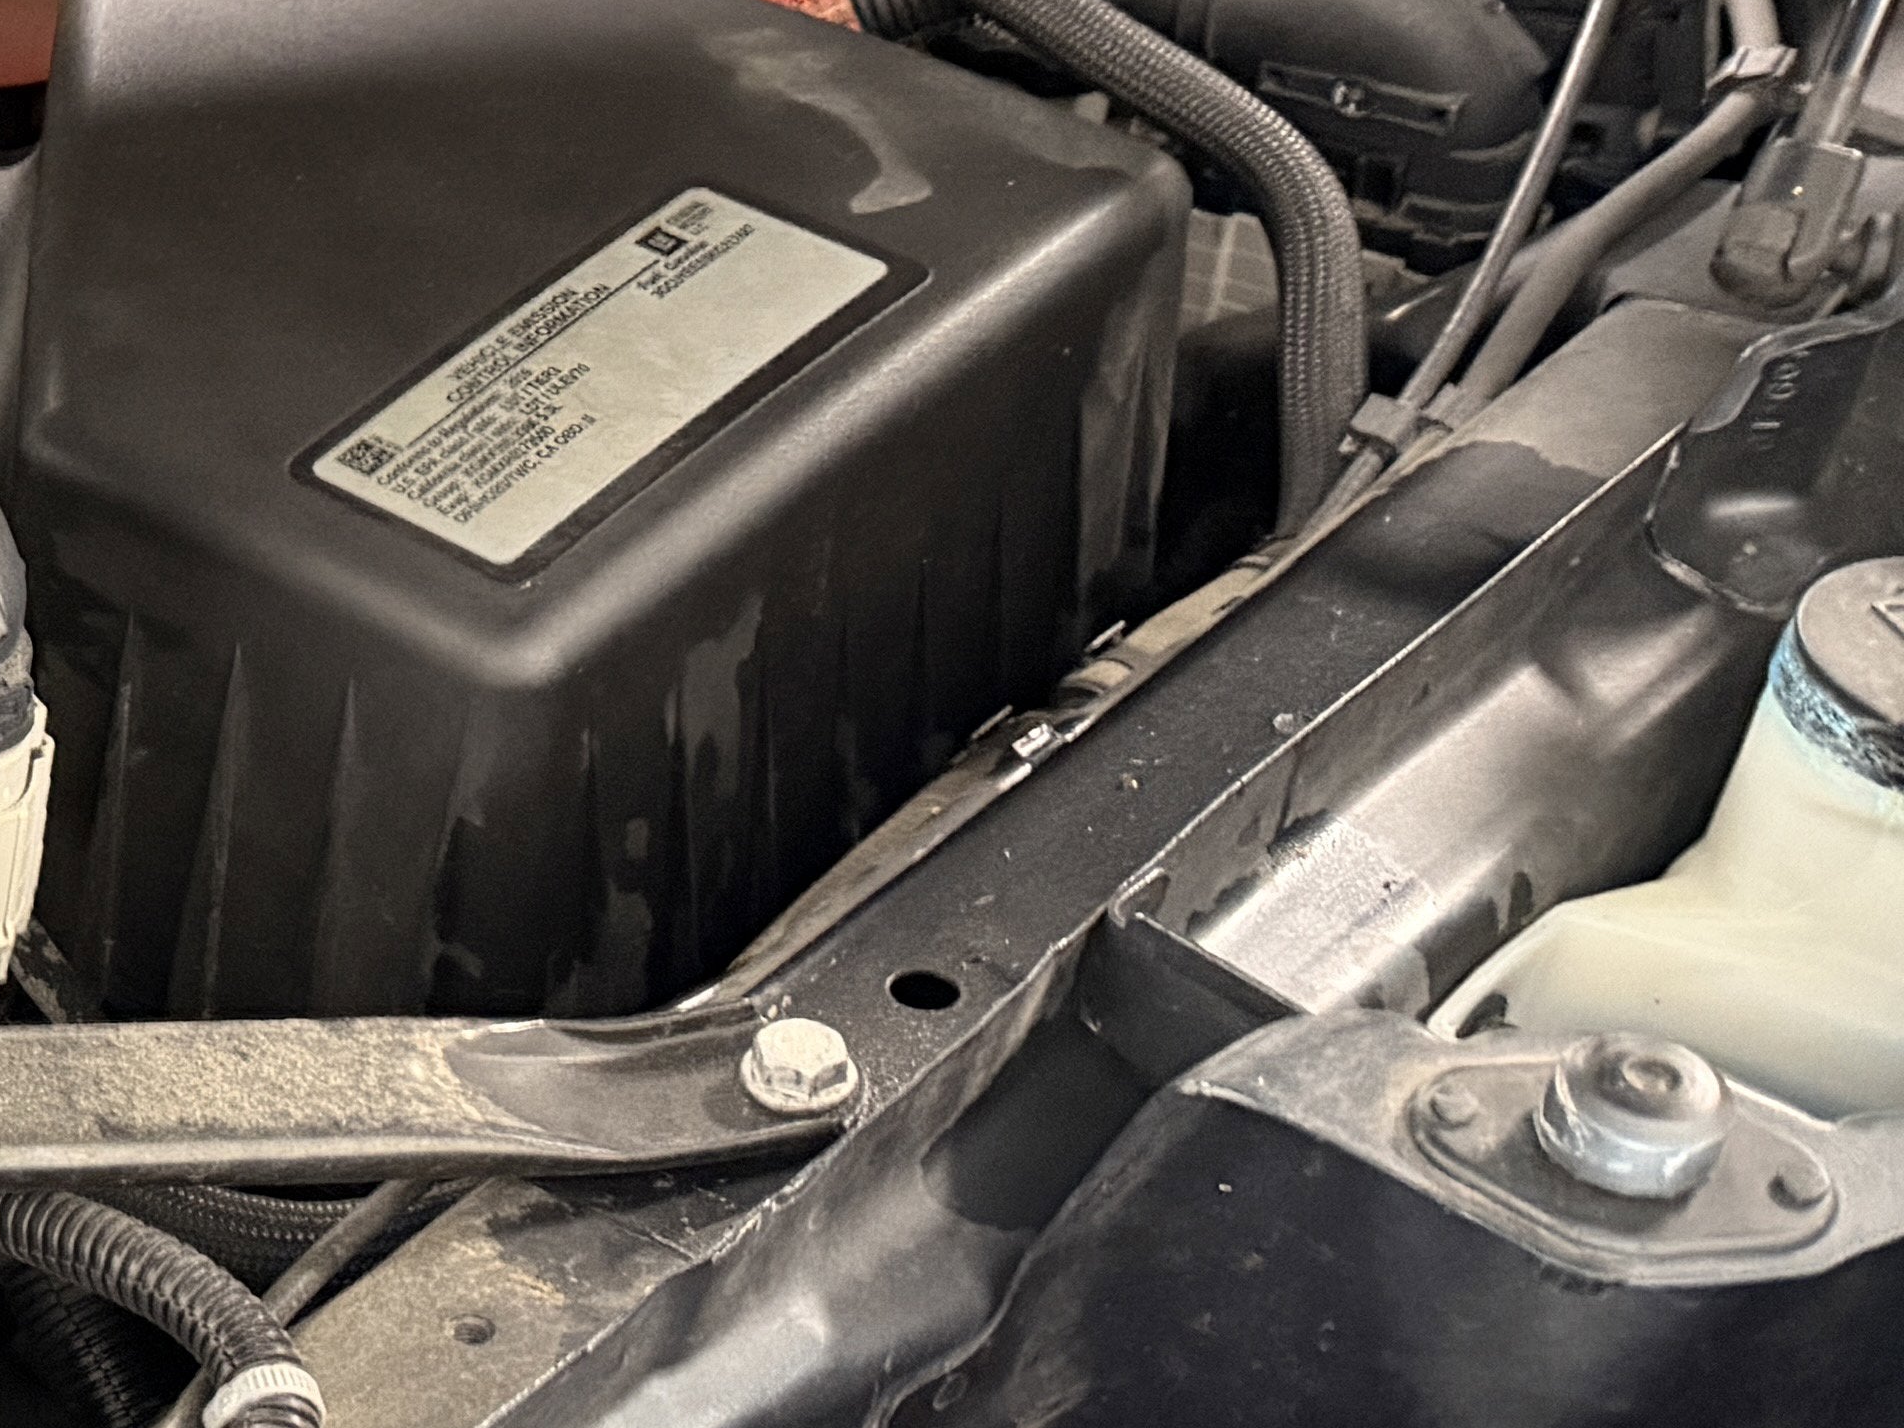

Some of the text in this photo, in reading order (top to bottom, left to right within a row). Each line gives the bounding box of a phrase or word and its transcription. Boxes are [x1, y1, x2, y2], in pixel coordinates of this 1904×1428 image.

[443, 282, 610, 403] CONTROL INFORMATION
[444, 287, 578, 382] VEHICLE EMISSION
